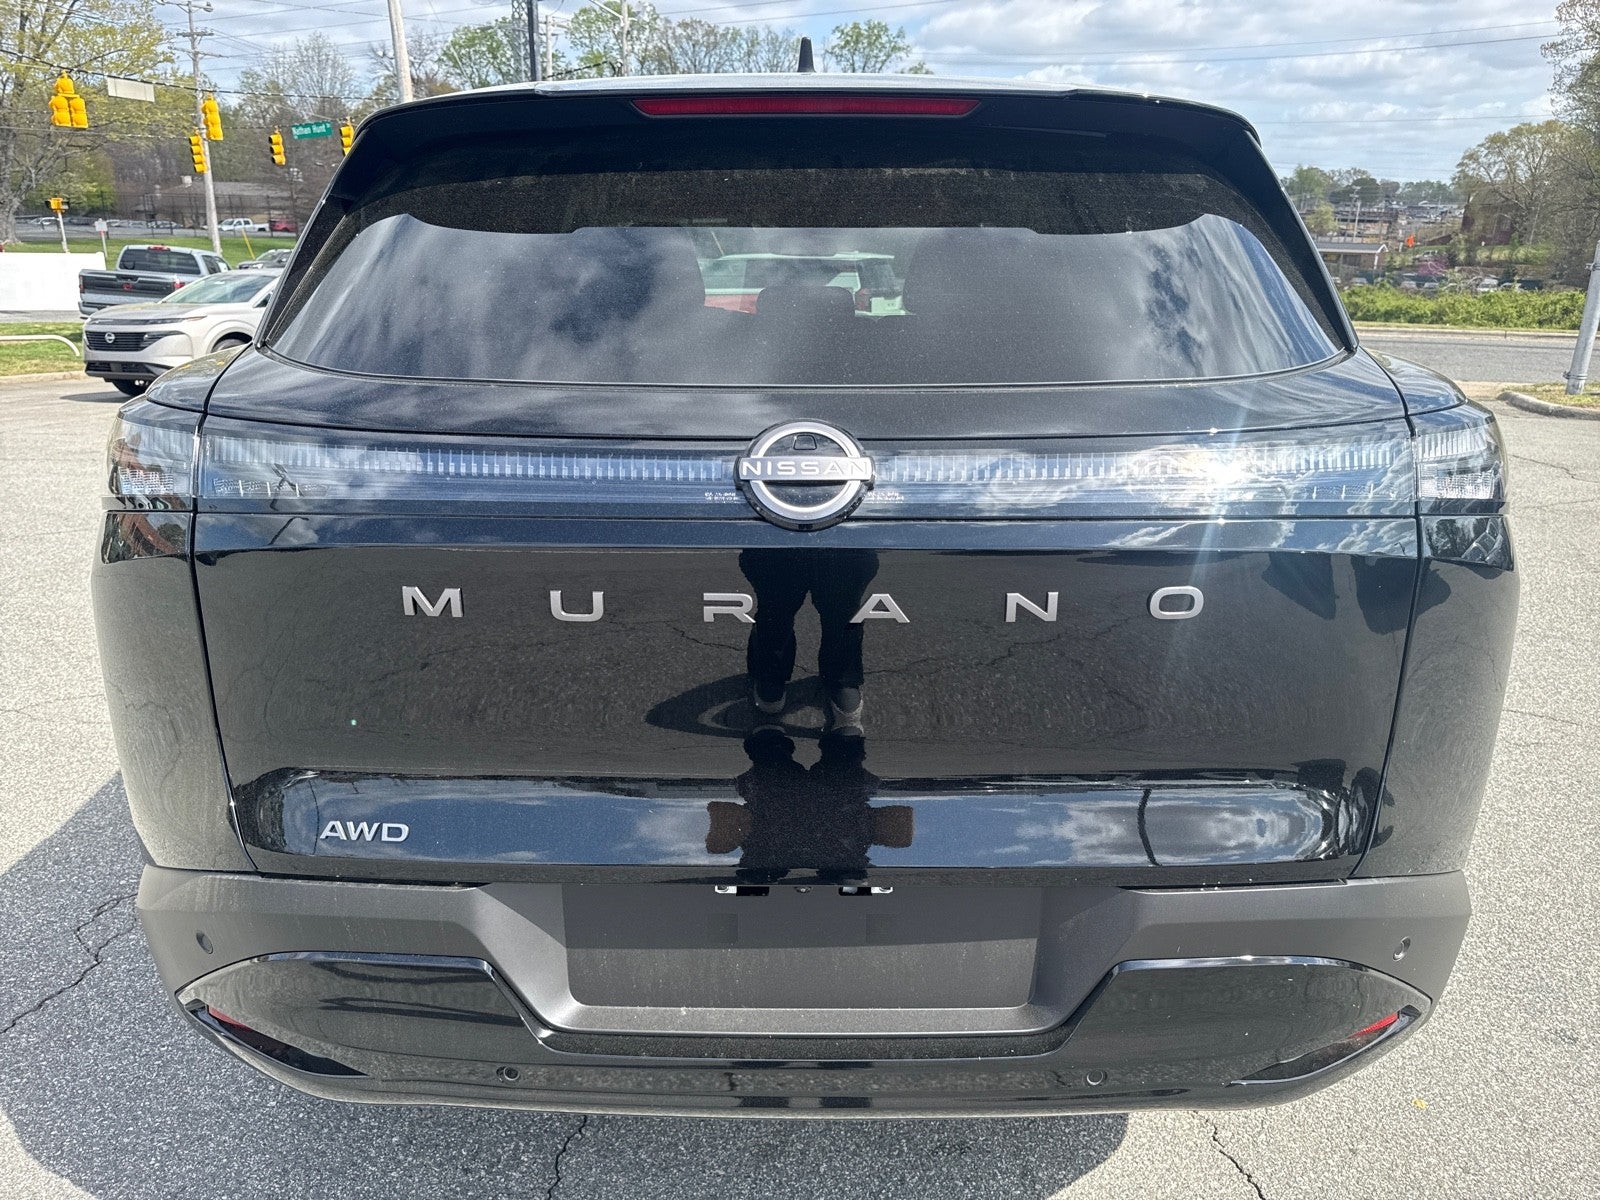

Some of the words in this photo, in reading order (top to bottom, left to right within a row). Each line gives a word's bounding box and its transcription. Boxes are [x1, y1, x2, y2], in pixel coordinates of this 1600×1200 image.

[742, 461, 870, 476] NISSAN
[402, 585, 1204, 623] MURANO
[320, 821, 409, 842] AWD
